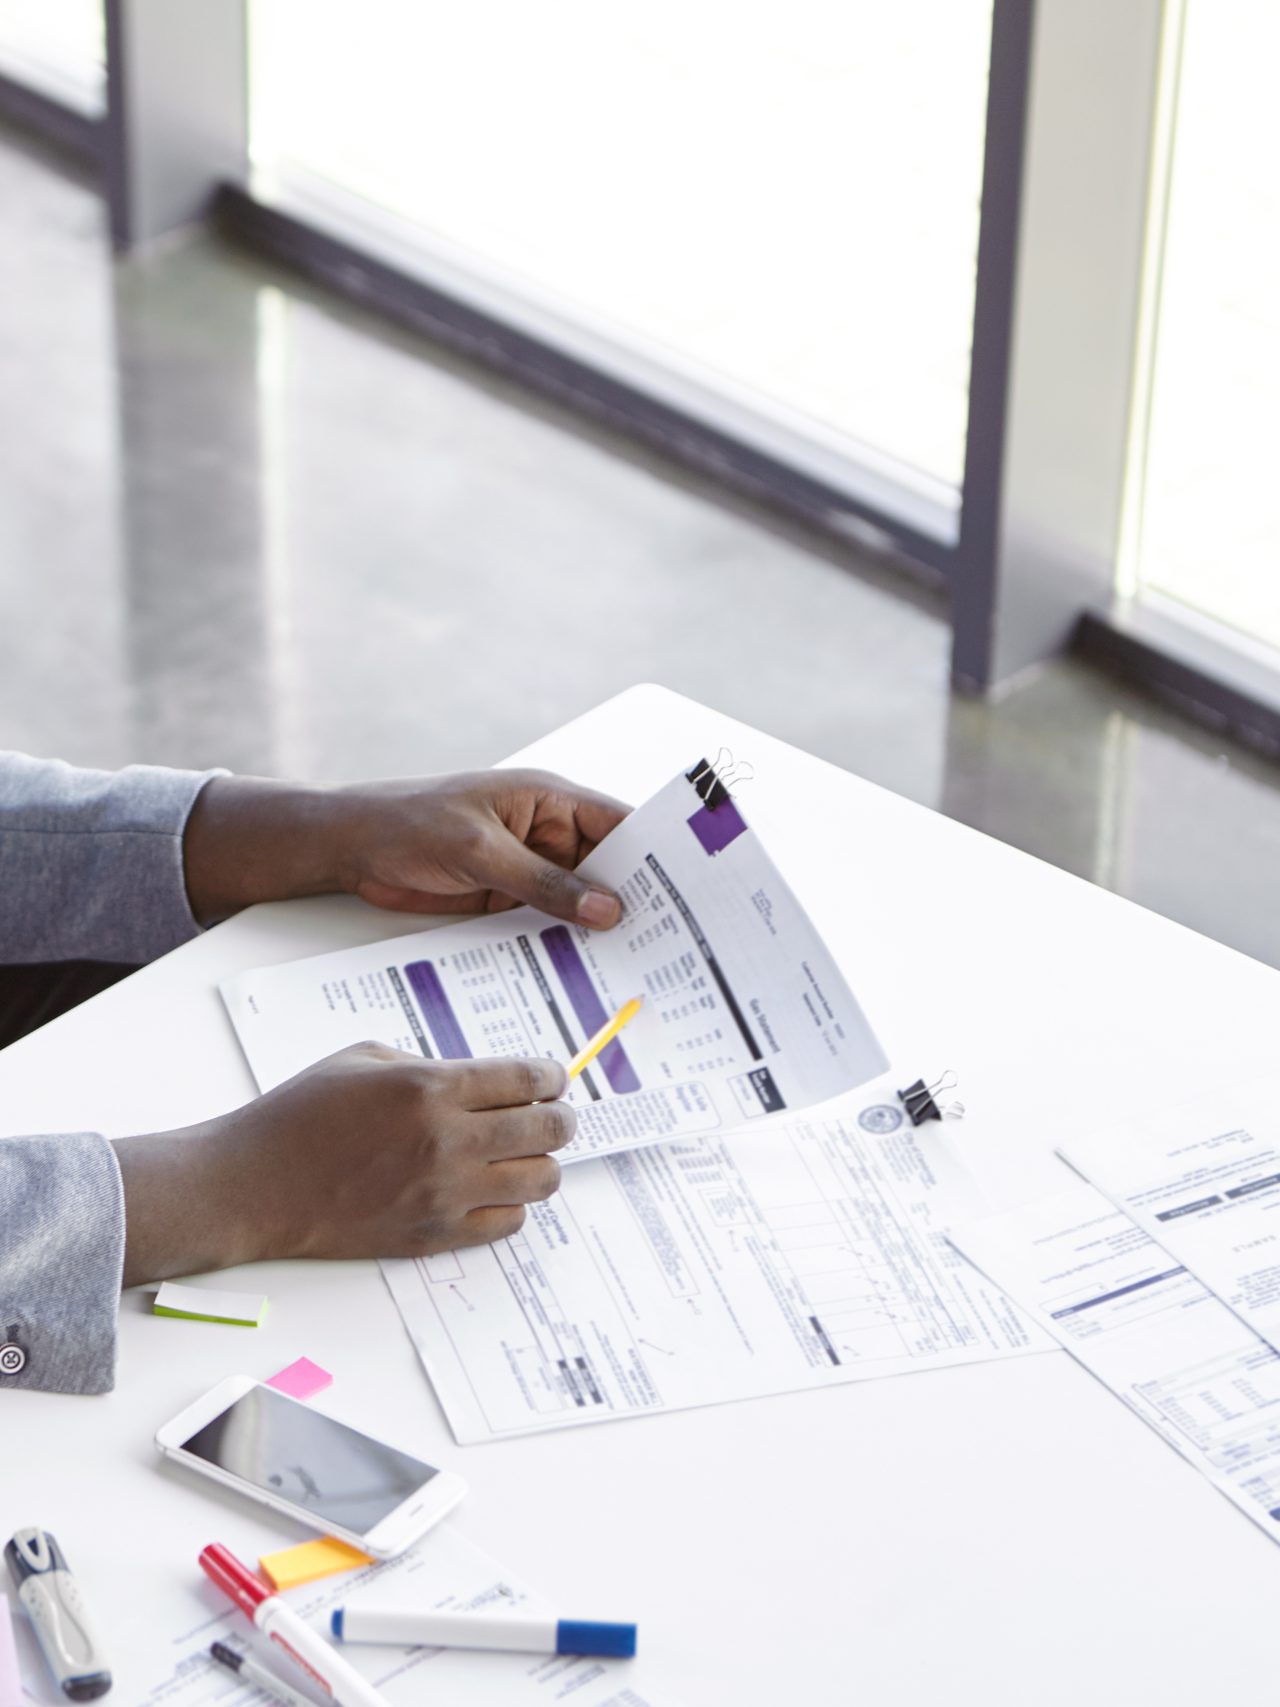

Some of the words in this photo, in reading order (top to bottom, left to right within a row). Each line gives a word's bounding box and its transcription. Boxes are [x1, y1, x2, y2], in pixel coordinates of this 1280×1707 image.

[747, 997, 762, 1015] Gas
[755, 1013, 781, 1054] Statement
[687, 1082, 700, 1096] Gas
[694, 1095, 709, 1112] Safe
[914, 1151, 939, 1186] Cambridge
[549, 1213, 570, 1245] Cambridge
